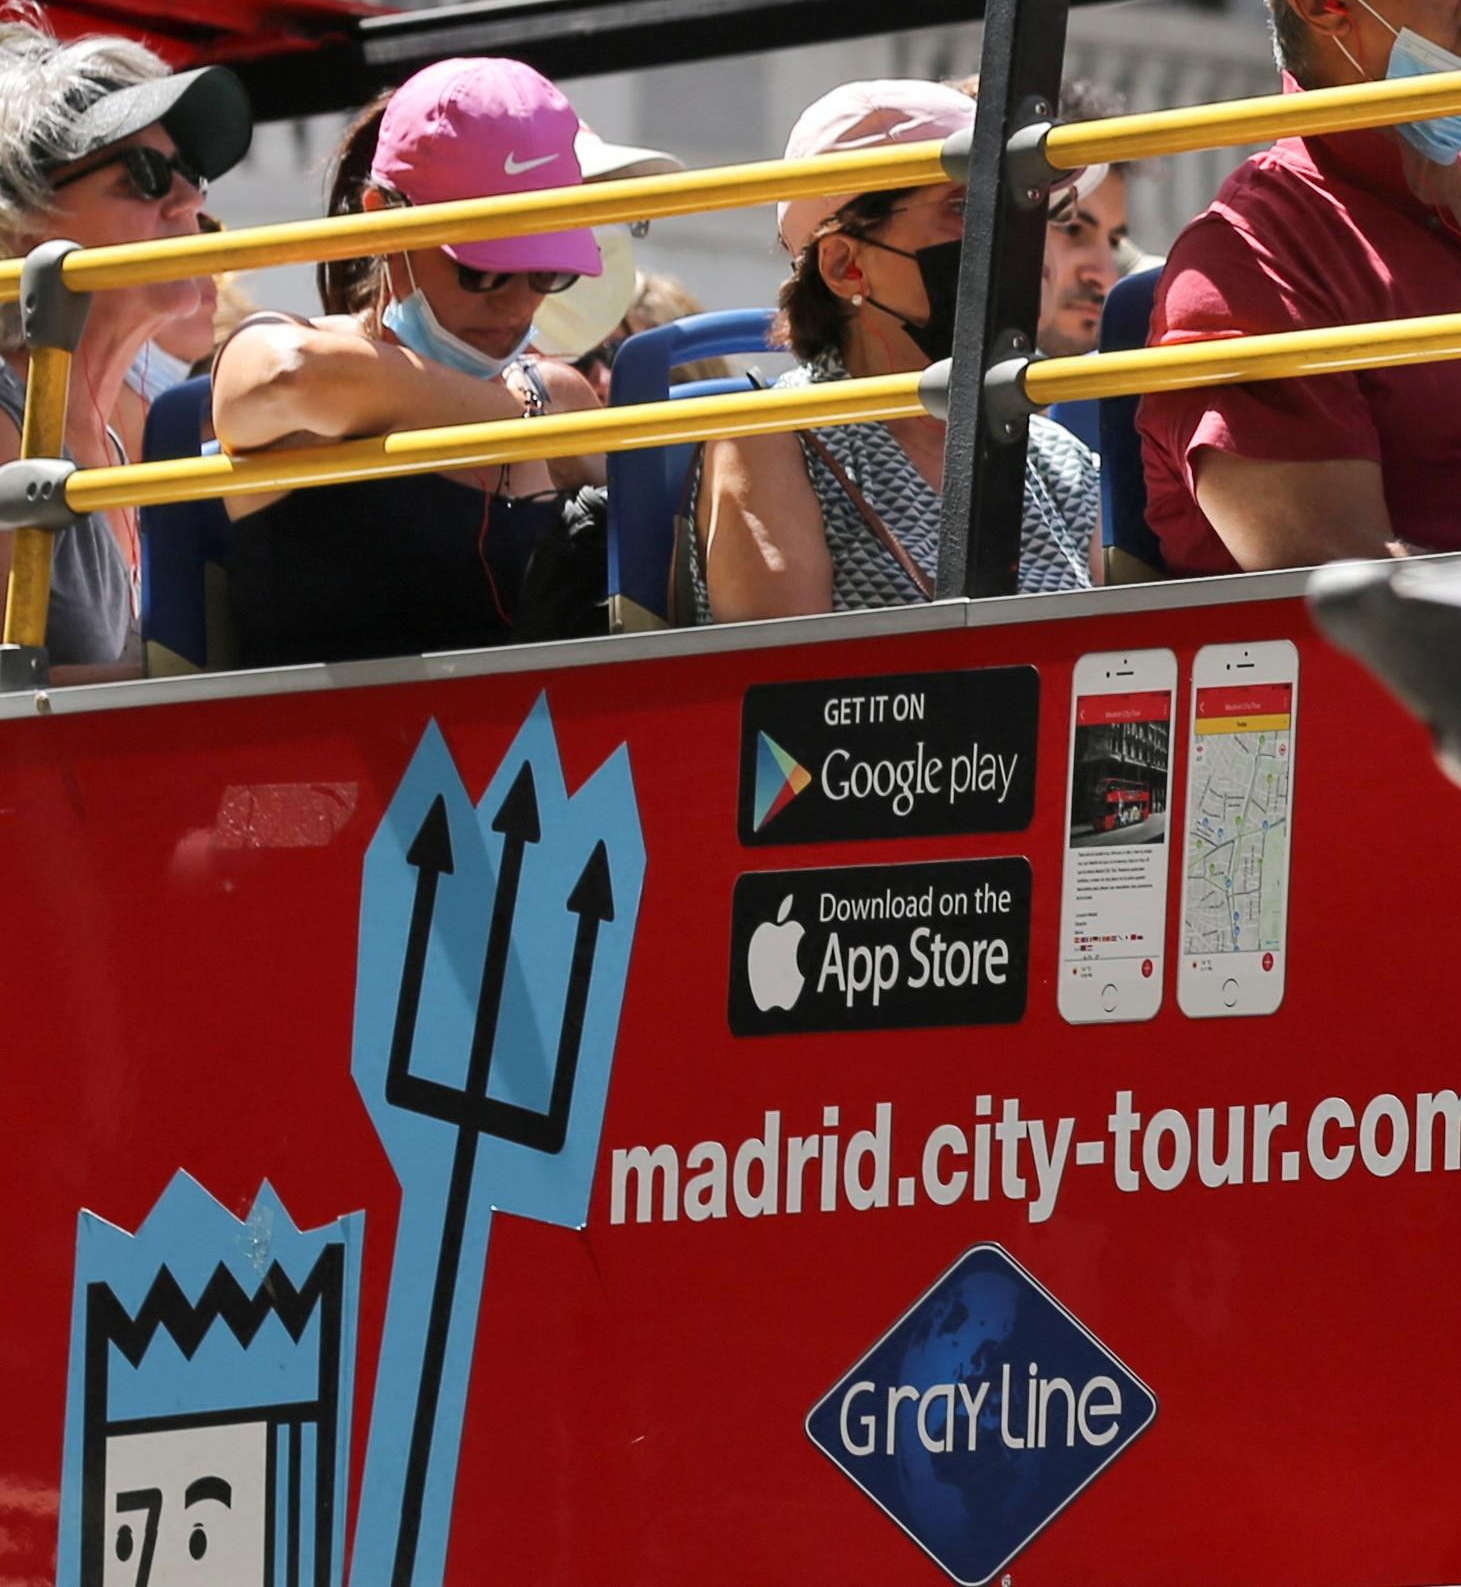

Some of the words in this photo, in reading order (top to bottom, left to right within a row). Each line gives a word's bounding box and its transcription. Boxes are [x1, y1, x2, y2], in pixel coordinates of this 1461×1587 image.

[825, 698, 865, 726] GET
[869, 696, 888, 723] IT
[892, 694, 925, 721] ON
[821, 741, 943, 816] Google
[949, 743, 1018, 804] play
[819, 886, 934, 922] Download
[938, 892, 969, 916] on
[974, 883, 1011, 915] the
[816, 932, 900, 1008] App
[907, 926, 1009, 989] Store
